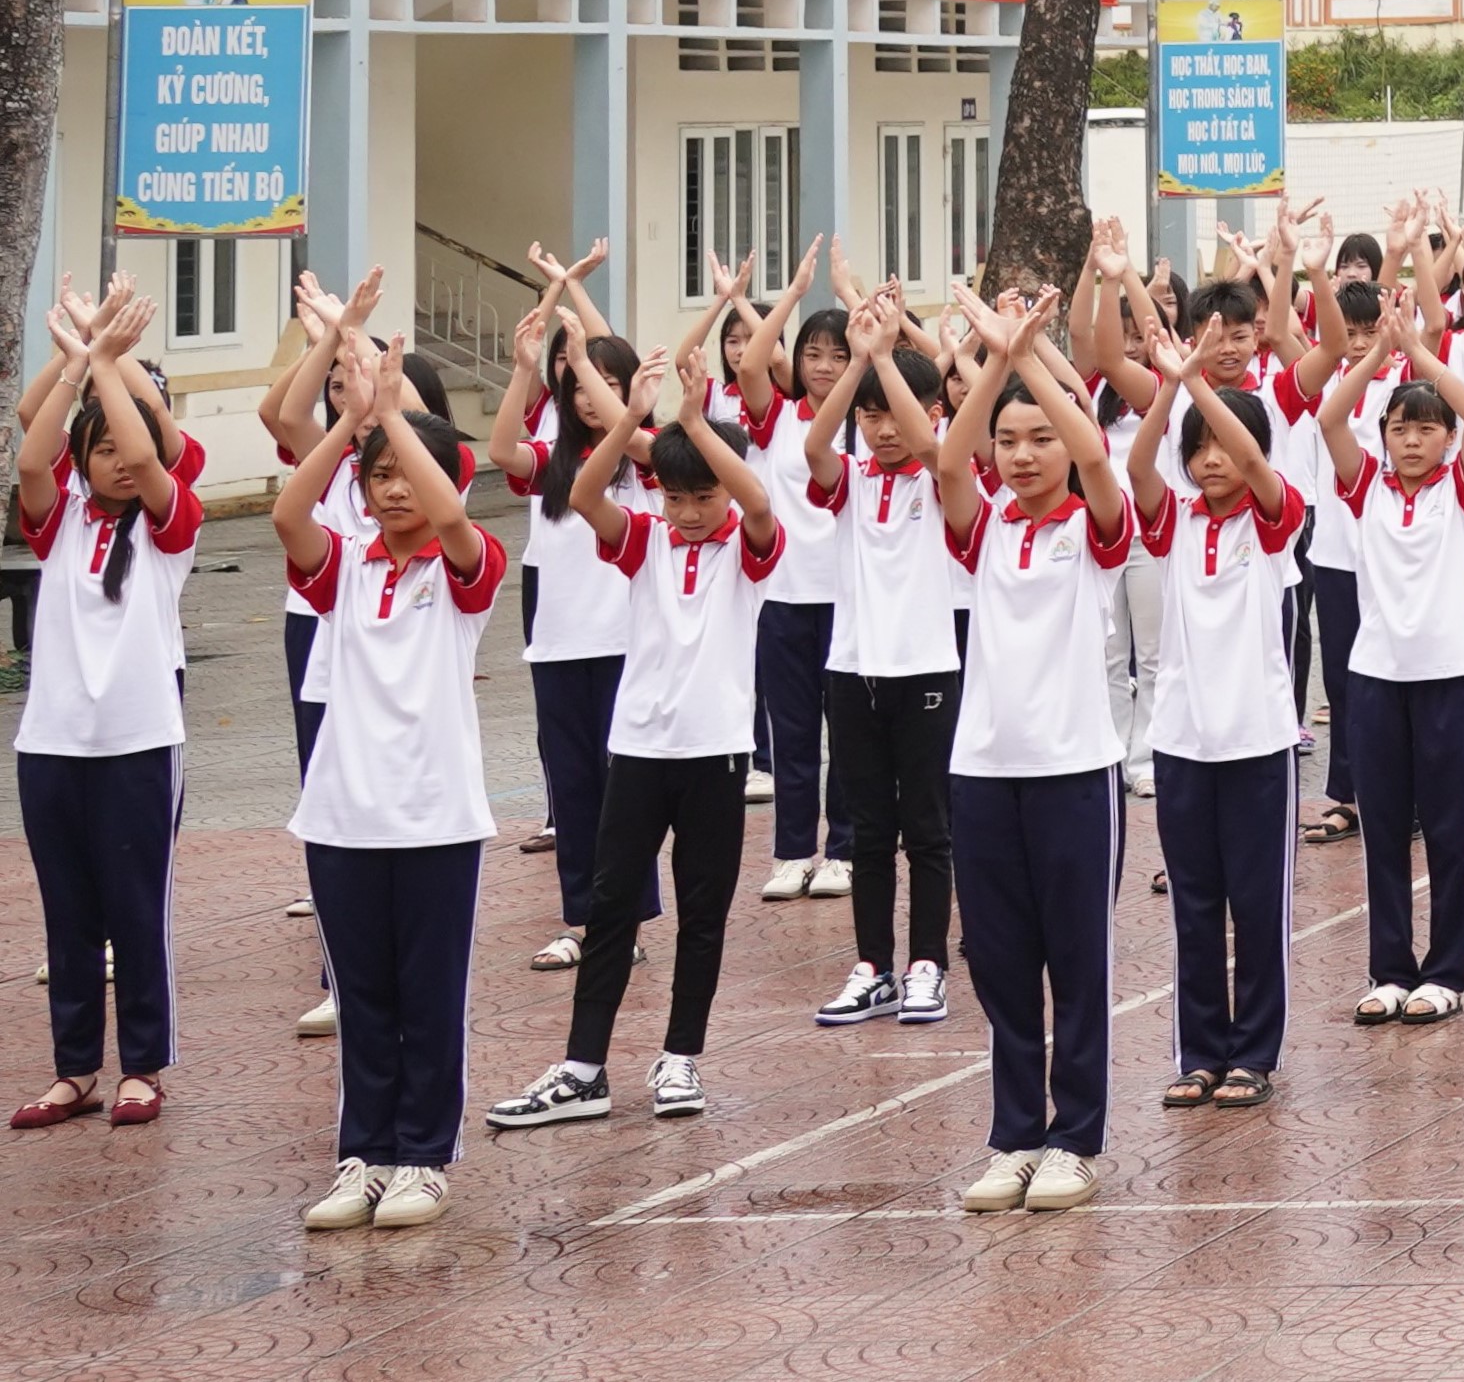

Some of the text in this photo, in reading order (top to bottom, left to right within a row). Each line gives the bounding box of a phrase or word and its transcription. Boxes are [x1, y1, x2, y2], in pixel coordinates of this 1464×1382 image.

[161, 16, 268, 59] ĐOÀN KẾT,
[1170, 55, 1193, 82] HỌC
[1223, 54, 1245, 81] HỌC
[1246, 54, 1272, 80] BẠN,
[158, 65, 270, 108] KỶ CƯƠNG,
[1168, 80, 1274, 114] HỌC TRONG SÁCH VỞ,
[155, 117, 269, 153] GIÚP NHAU
[1187, 112, 1256, 146] HỌC Ở TẤT CẢ
[1177, 148, 1266, 179] MỌI NƠI, MỌI LÚC
[137, 161, 284, 207] CÙNG TIẾN BỘ
